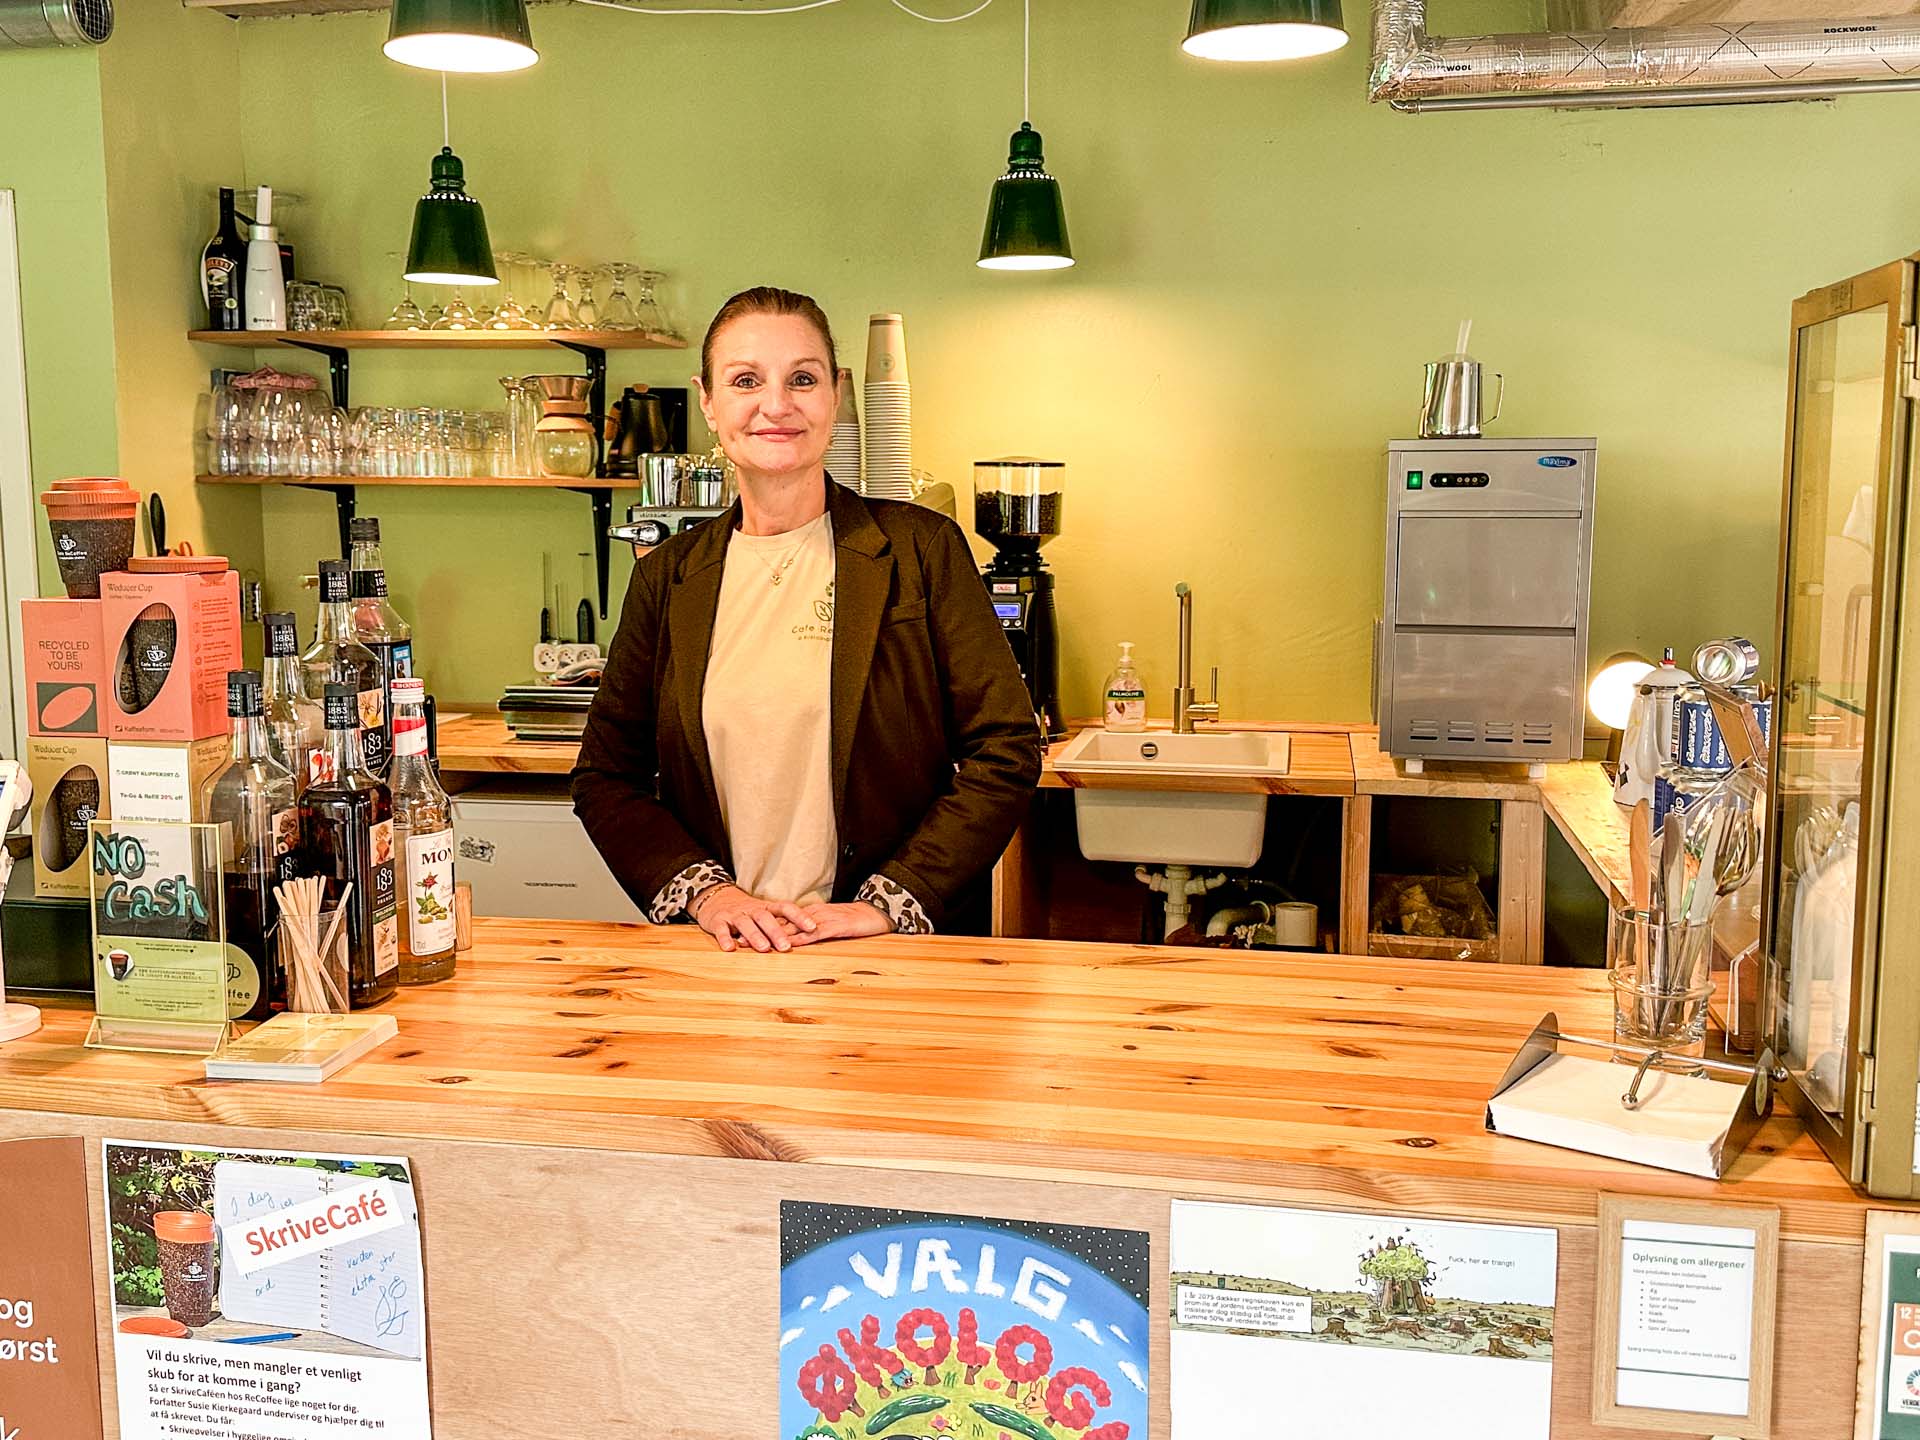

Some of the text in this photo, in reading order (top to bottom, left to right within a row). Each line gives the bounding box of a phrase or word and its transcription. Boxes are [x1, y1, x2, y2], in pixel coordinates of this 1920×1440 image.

[138, 584, 153, 593] Cup
[328, 580, 347, 588] 1883
[274, 634, 294, 642] 1883
[39, 641, 89, 650] RECYCLED
[50, 651, 78, 660] TO BE
[47, 661, 83, 670] YOURS!
[328, 706, 348, 714] 1883
[63, 746, 77, 755] Cup
[94, 831, 145, 880] NO
[247, 1192, 275, 1210] dag
[246, 1189, 388, 1256] SkriveCafé
[1633, 1252, 1678, 1266] Oplysning
[1698, 1258, 1746, 1269] allergener
[848, 1238, 1072, 1321] VÆLG
[1184, 1313, 1208, 1321] rumme
[1209, 1315, 1225, 1323] 50%
[1900, 1306, 1911, 1319] 12
[147, 1350, 362, 1383] Vil du skrive, men mangler et venligt
[148, 1368, 175, 1380] skub
[178, 1370, 194, 1382] for
[198, 1374, 210, 1384] at
[213, 1373, 257, 1388] komme
[266, 1381, 301, 1394] gang?
[149, 1383, 158, 1393] Så
[171, 1385, 226, 1401] SkriveCaféen
[228, 1391, 242, 1400] hos
[244, 1393, 283, 1406] ReCoffee
[284, 1397, 300, 1408] lige
[302, 1401, 327, 1411] noget
[328, 1401, 341, 1411] for
[343, 1403, 360, 1414] dig.
[149, 1397, 385, 1429] Forfatter Susie Kierkegaard underviser og hjælper dig til
[150, 1410, 159, 1418] at
[161, 1410, 169, 1419] få
[206, 1415, 219, 1424] Du
